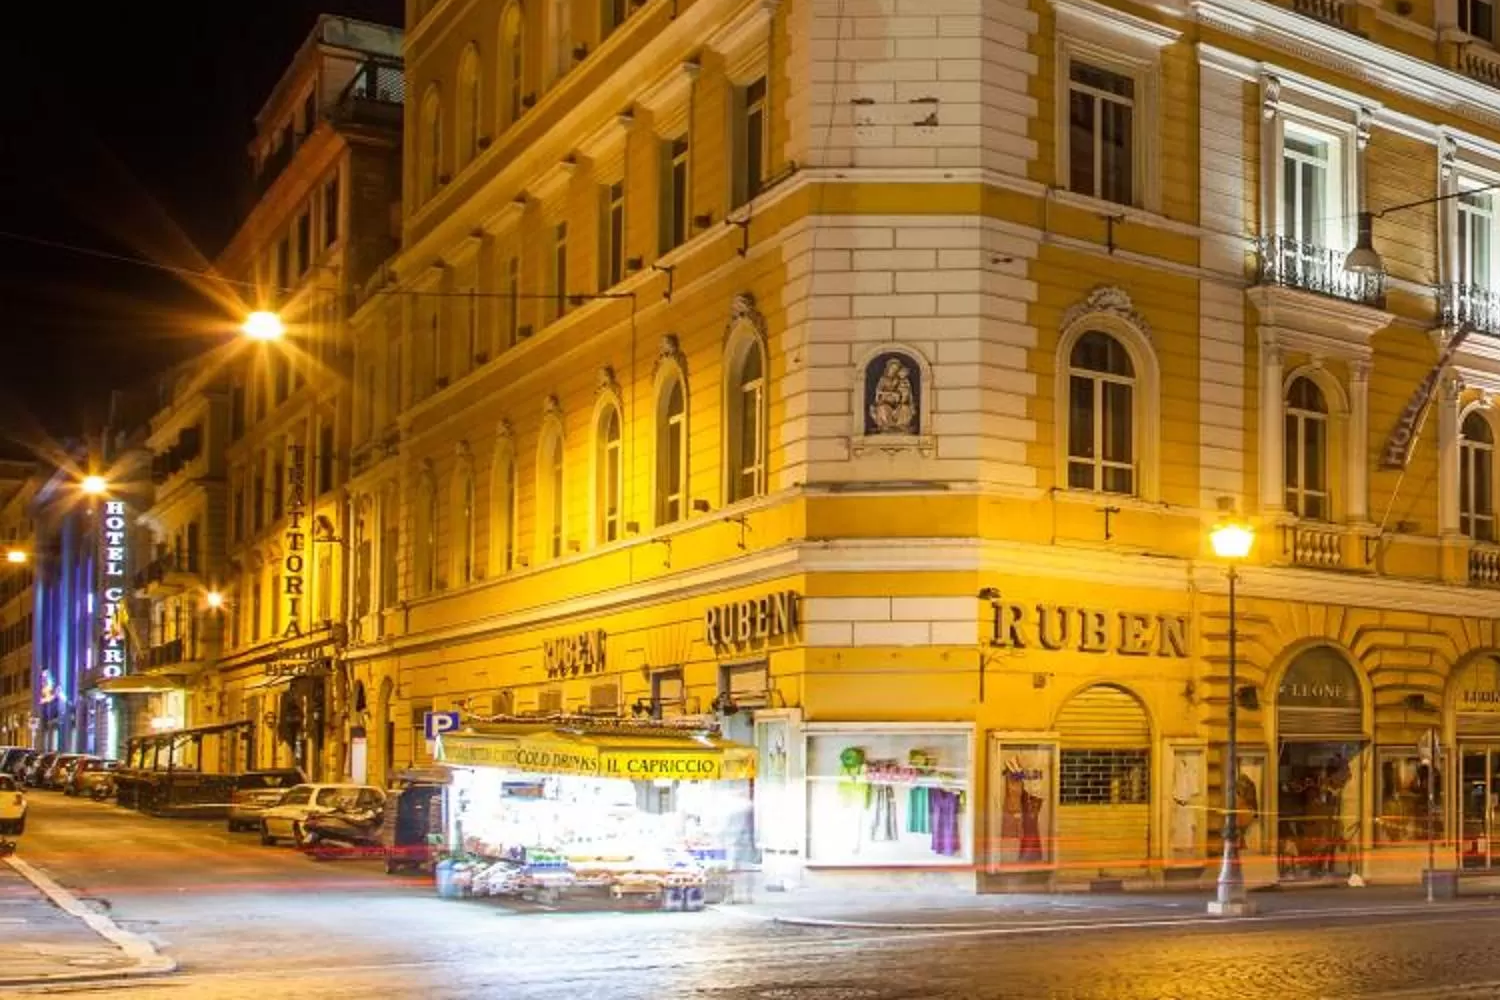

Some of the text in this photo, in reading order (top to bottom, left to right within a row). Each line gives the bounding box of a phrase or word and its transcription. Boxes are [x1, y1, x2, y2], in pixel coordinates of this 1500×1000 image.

[104, 501, 125, 575] HOTEL
[283, 445, 305, 638] TRATTORIA
[704, 590, 798, 647] RUBEN
[990, 601, 1190, 658] RUBEN
[432, 715, 453, 737] P
[516, 749, 549, 767] COLD
[553, 752, 597, 772] DRINKS
[607, 759, 715, 773] IL CAPRICCIO
